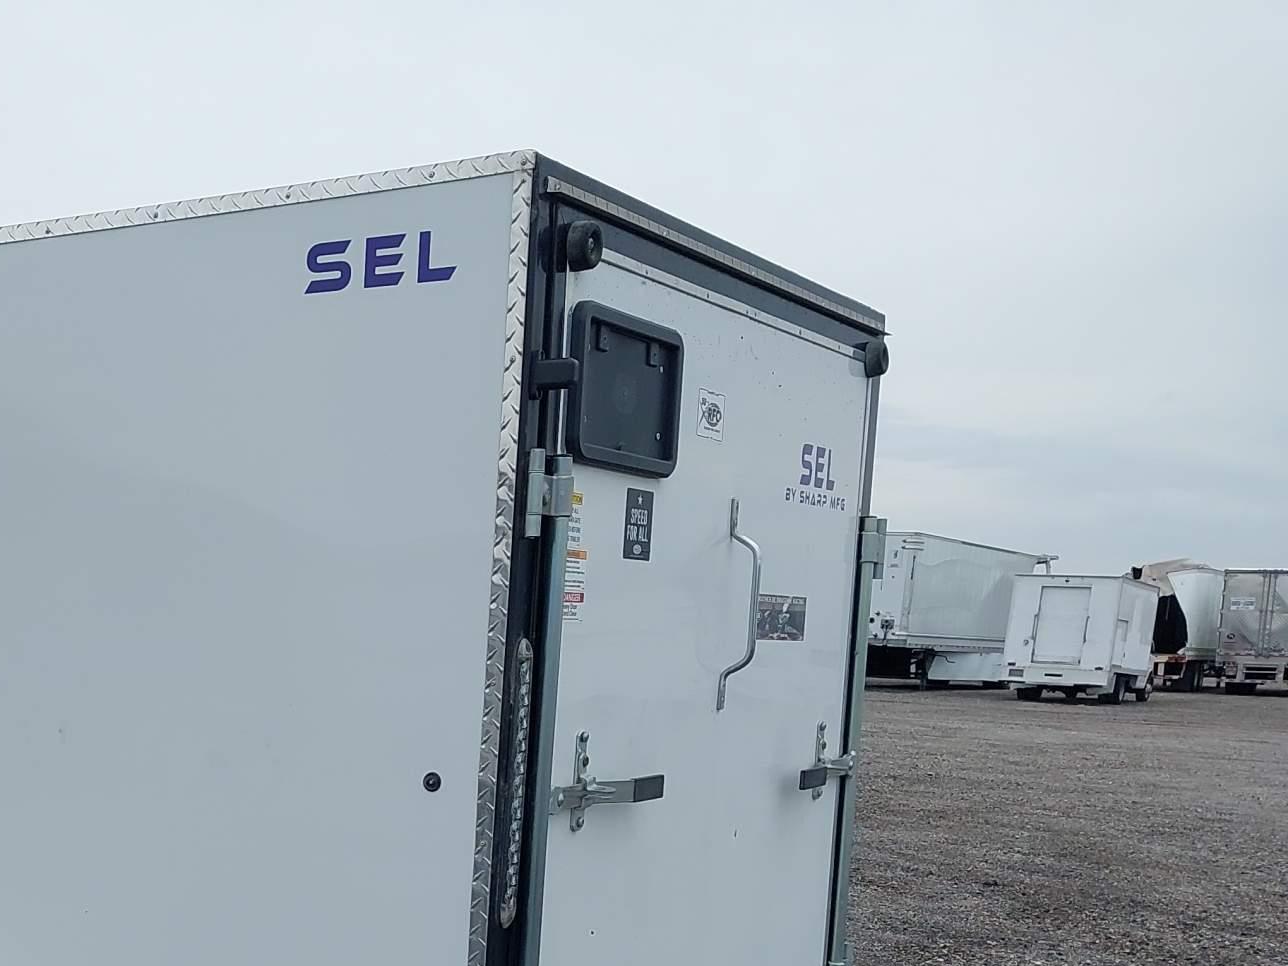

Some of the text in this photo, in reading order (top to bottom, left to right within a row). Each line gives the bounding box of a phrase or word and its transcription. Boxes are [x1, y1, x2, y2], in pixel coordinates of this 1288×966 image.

[304, 230, 457, 294] SEL
[800, 443, 835, 491] SEL
[785, 487, 846, 511] BY SHARP MFG
[630, 508, 648, 525] SPEED
[626, 524, 648, 542] FOR ALL
